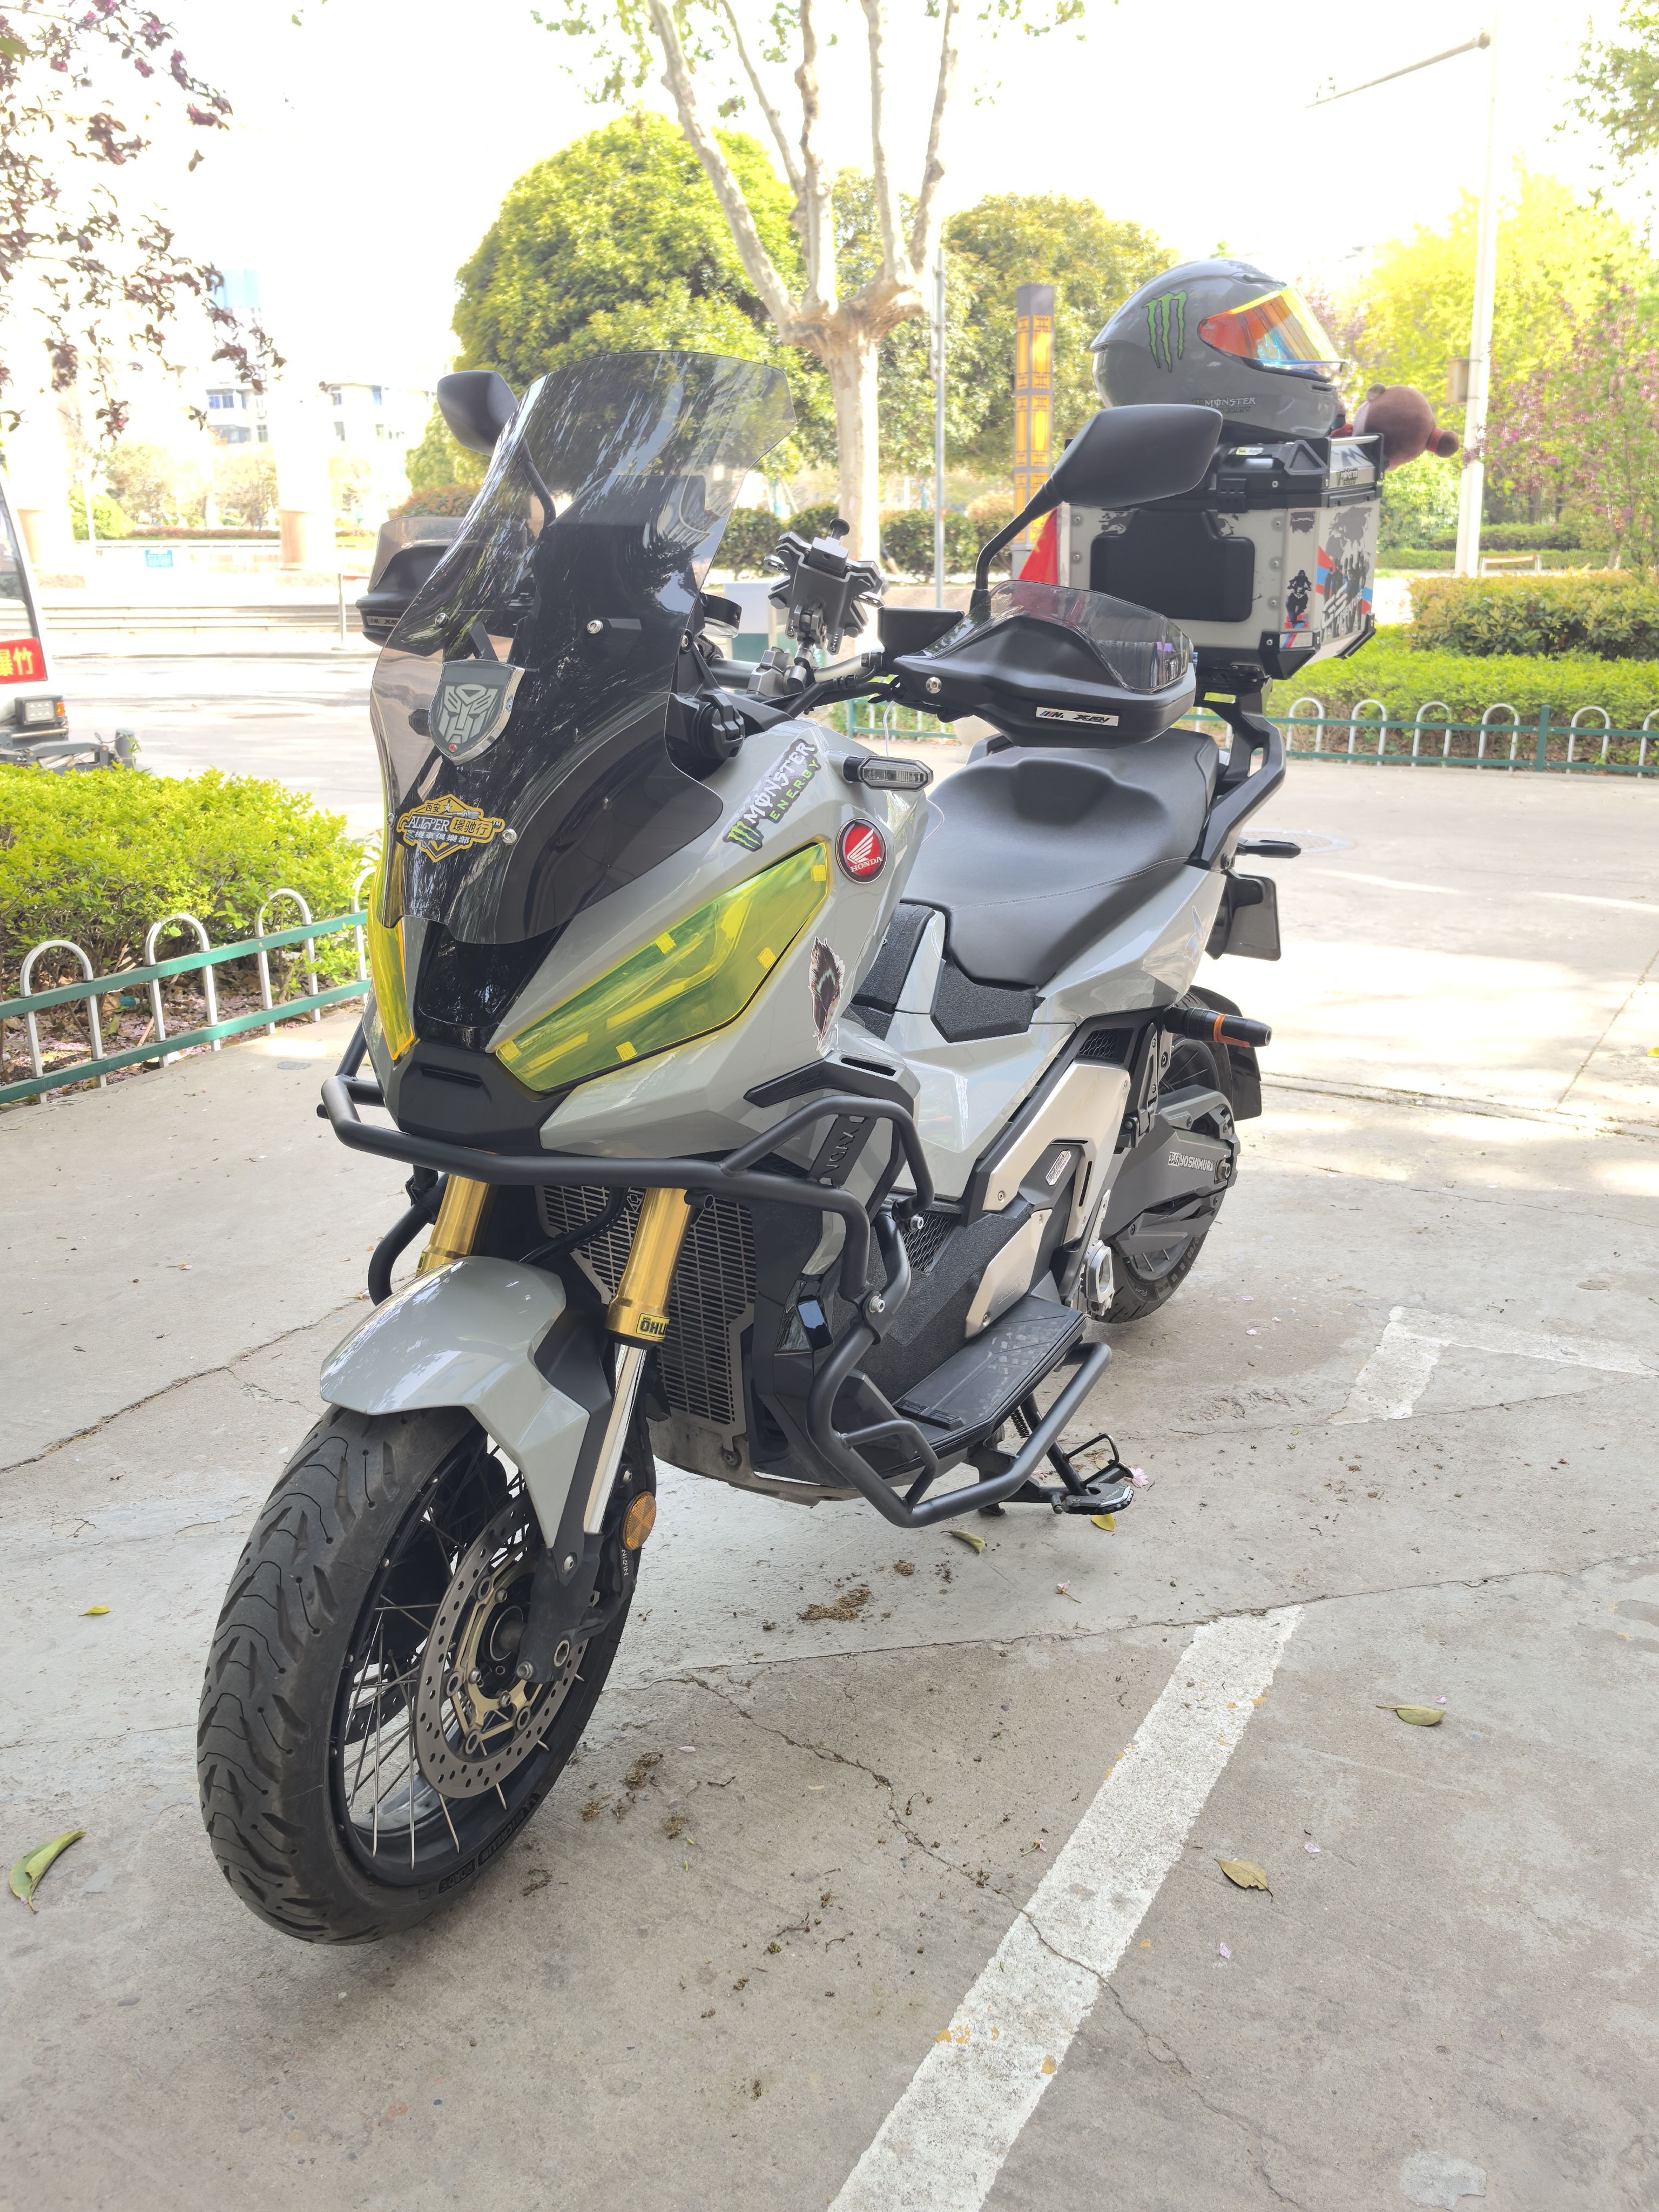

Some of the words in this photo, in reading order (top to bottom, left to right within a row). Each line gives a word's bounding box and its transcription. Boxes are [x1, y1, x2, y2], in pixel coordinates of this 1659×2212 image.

[1204, 397, 1257, 408] MONSTER
[743, 742, 815, 824] MONSTER
[769, 759, 819, 820] ENERGY
[426, 802, 441, 813] 西安
[850, 857, 883, 873] HONDA
[1179, 1154, 1213, 1172] YOSHIMURA
